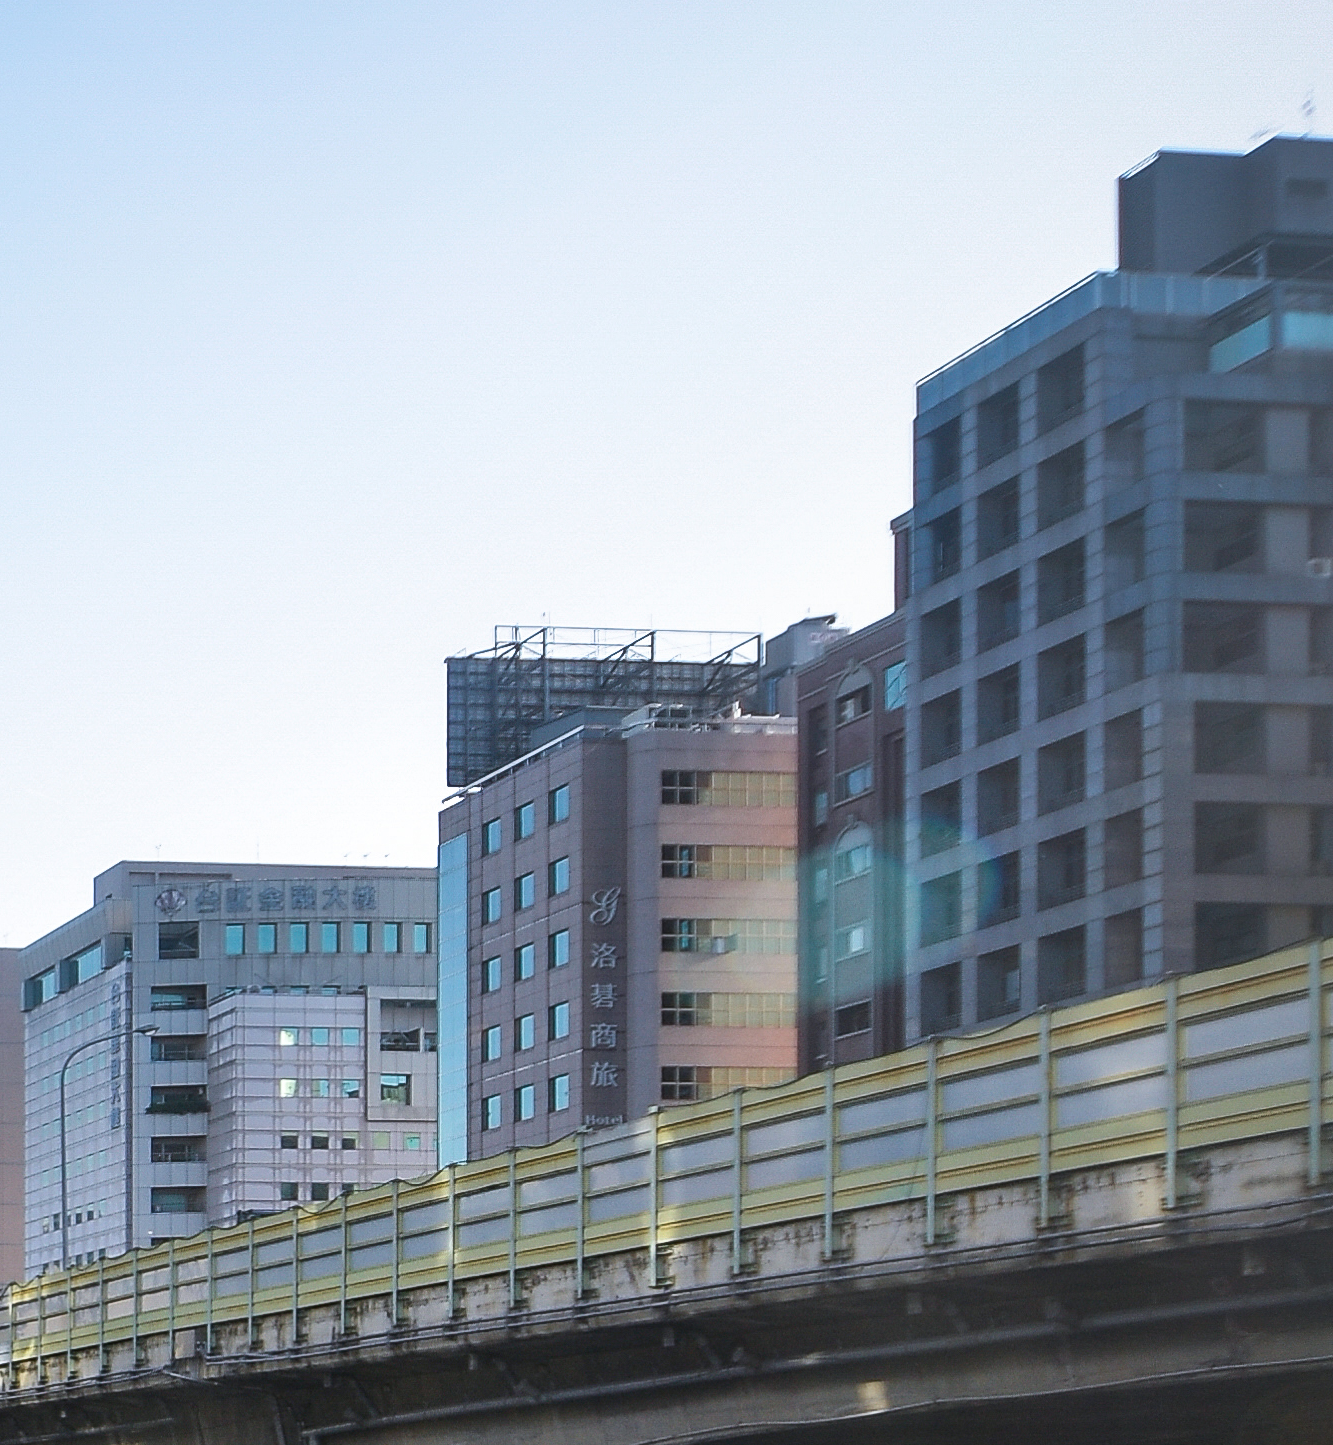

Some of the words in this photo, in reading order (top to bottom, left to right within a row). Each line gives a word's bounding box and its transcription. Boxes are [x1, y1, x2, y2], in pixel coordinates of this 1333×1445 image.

[590, 943, 619, 1087] 洛碁商旅
[585, 1114, 624, 1126] Hotel
